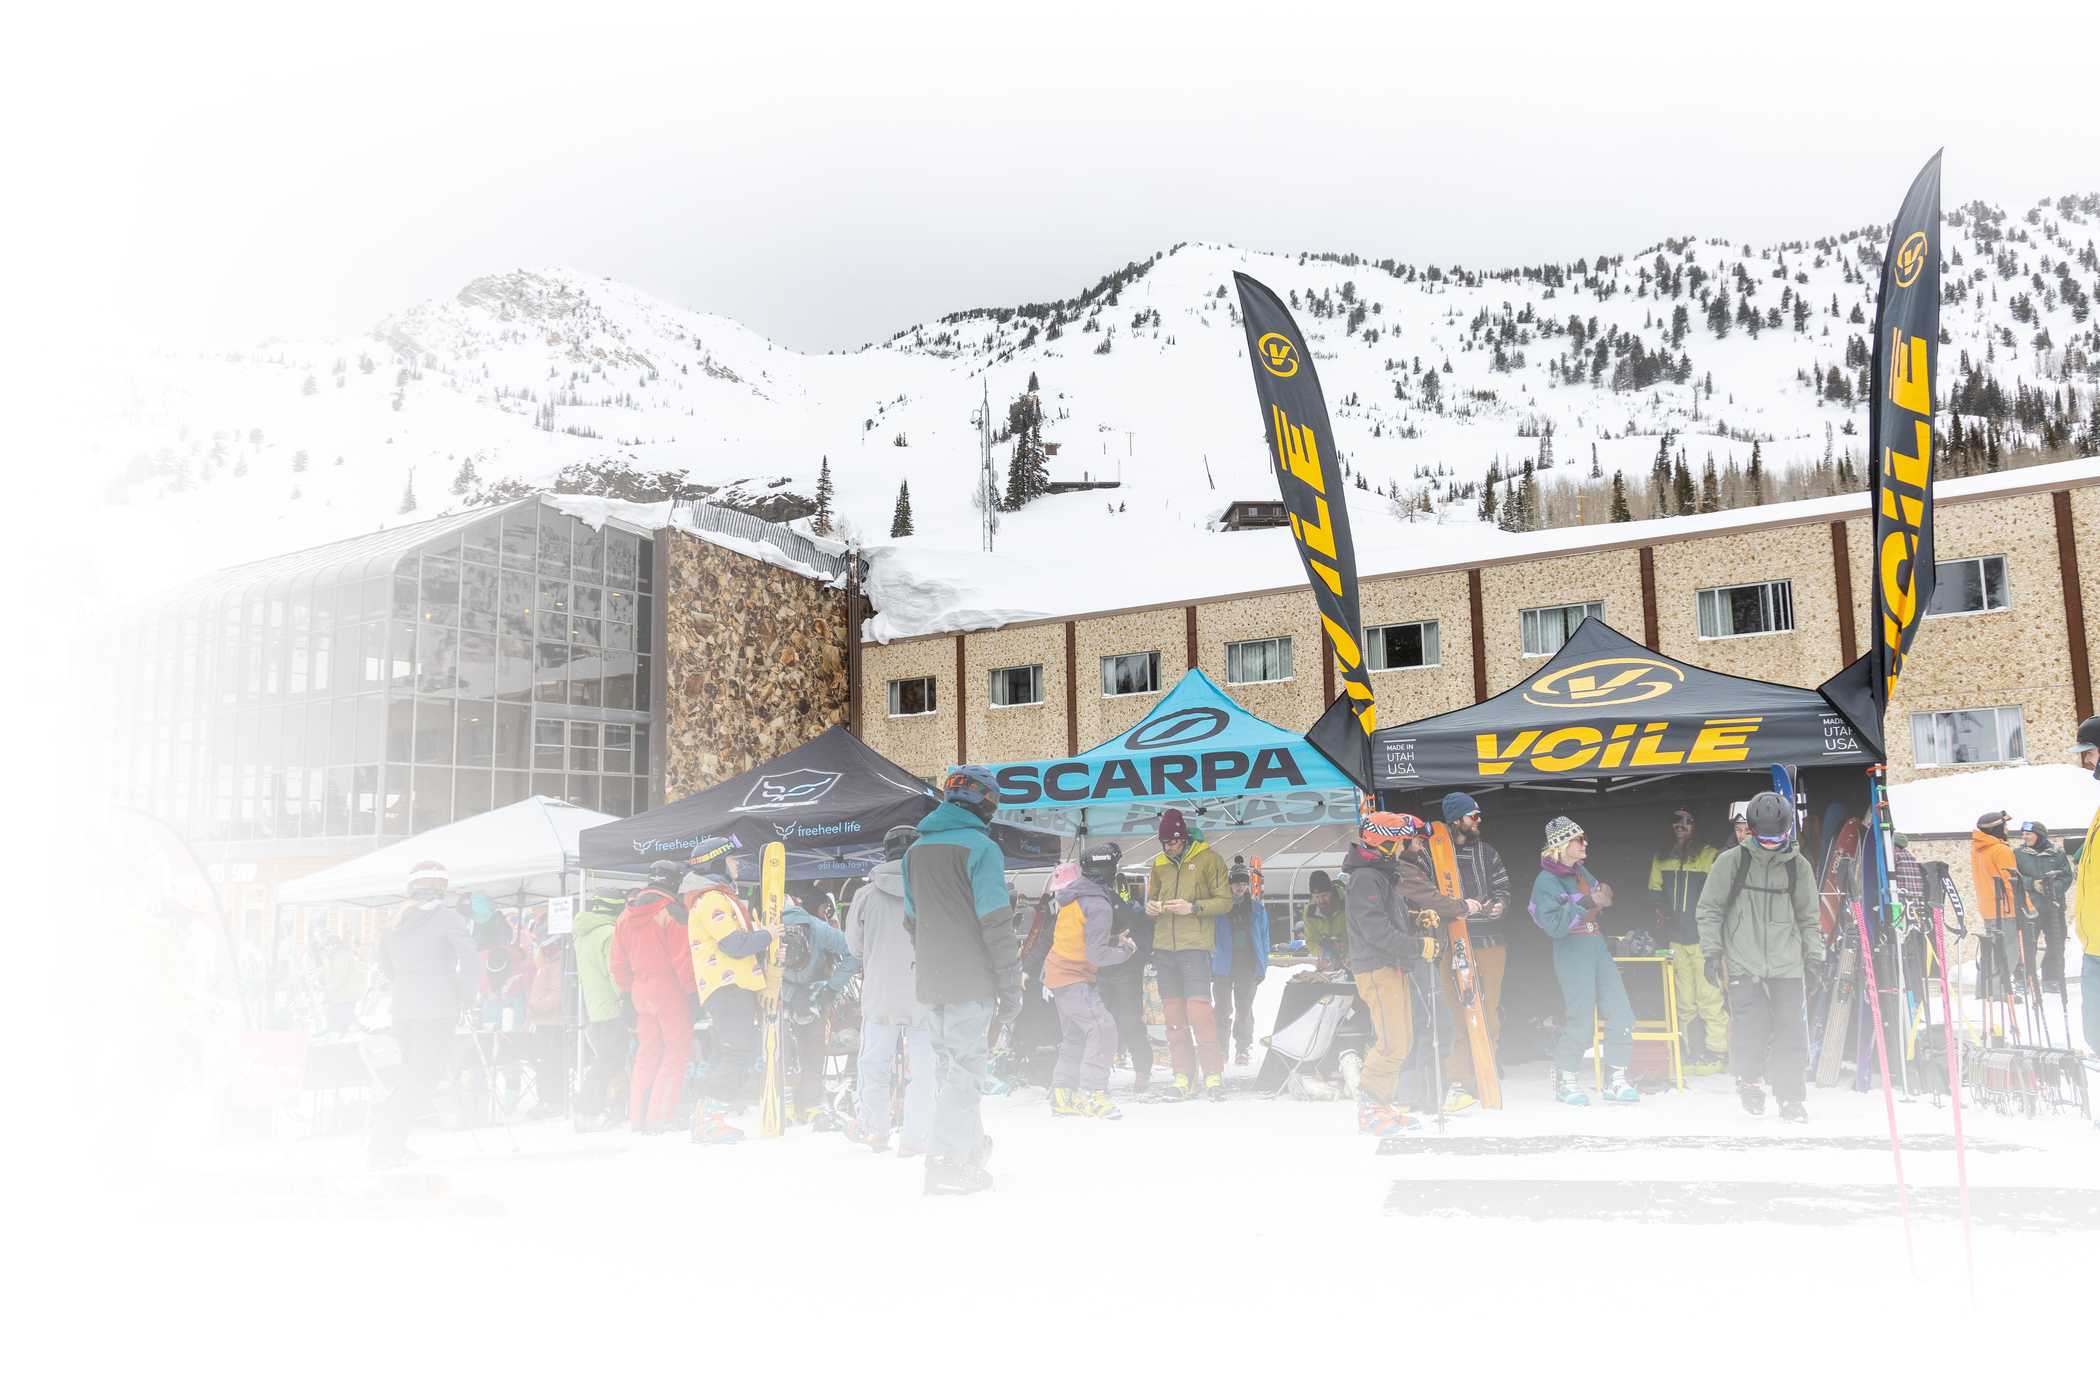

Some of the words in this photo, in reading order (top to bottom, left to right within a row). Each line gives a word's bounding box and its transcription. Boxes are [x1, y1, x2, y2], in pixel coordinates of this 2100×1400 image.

[1825, 737, 1858, 750] USA
[1387, 752, 1415, 762] UTAH
[1388, 762, 1416, 775] USA
[995, 747, 1307, 804] SCARPA
[798, 822, 842, 837] freeheel
[844, 820, 861, 833] life
